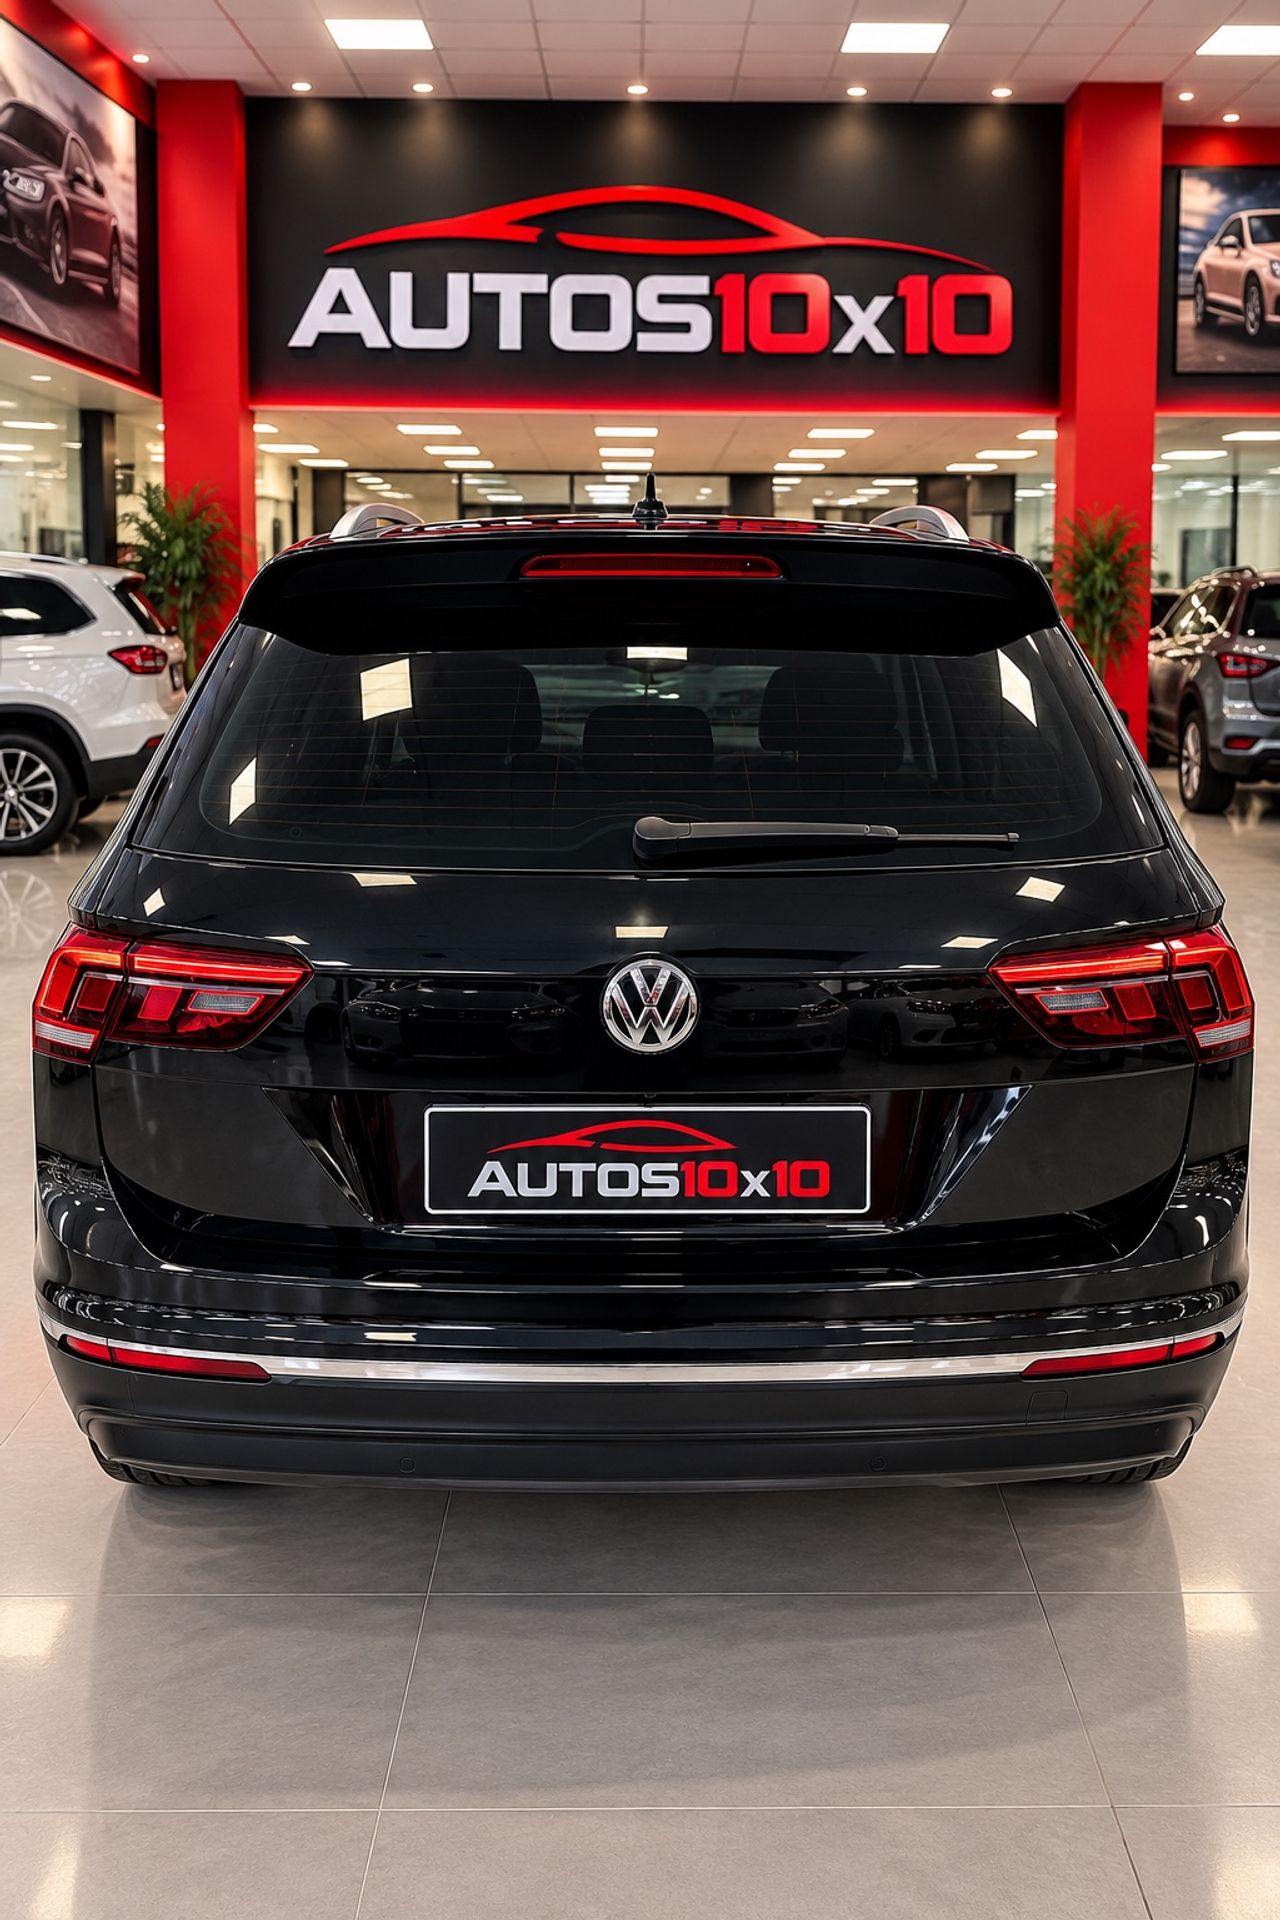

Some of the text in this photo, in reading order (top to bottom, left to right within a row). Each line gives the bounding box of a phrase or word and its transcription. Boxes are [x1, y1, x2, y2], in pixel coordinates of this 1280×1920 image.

[287, 267, 1013, 356] AUTOS10x10
[606, 961, 694, 1050] VW
[467, 1160, 830, 1198] AUTOS10x10
